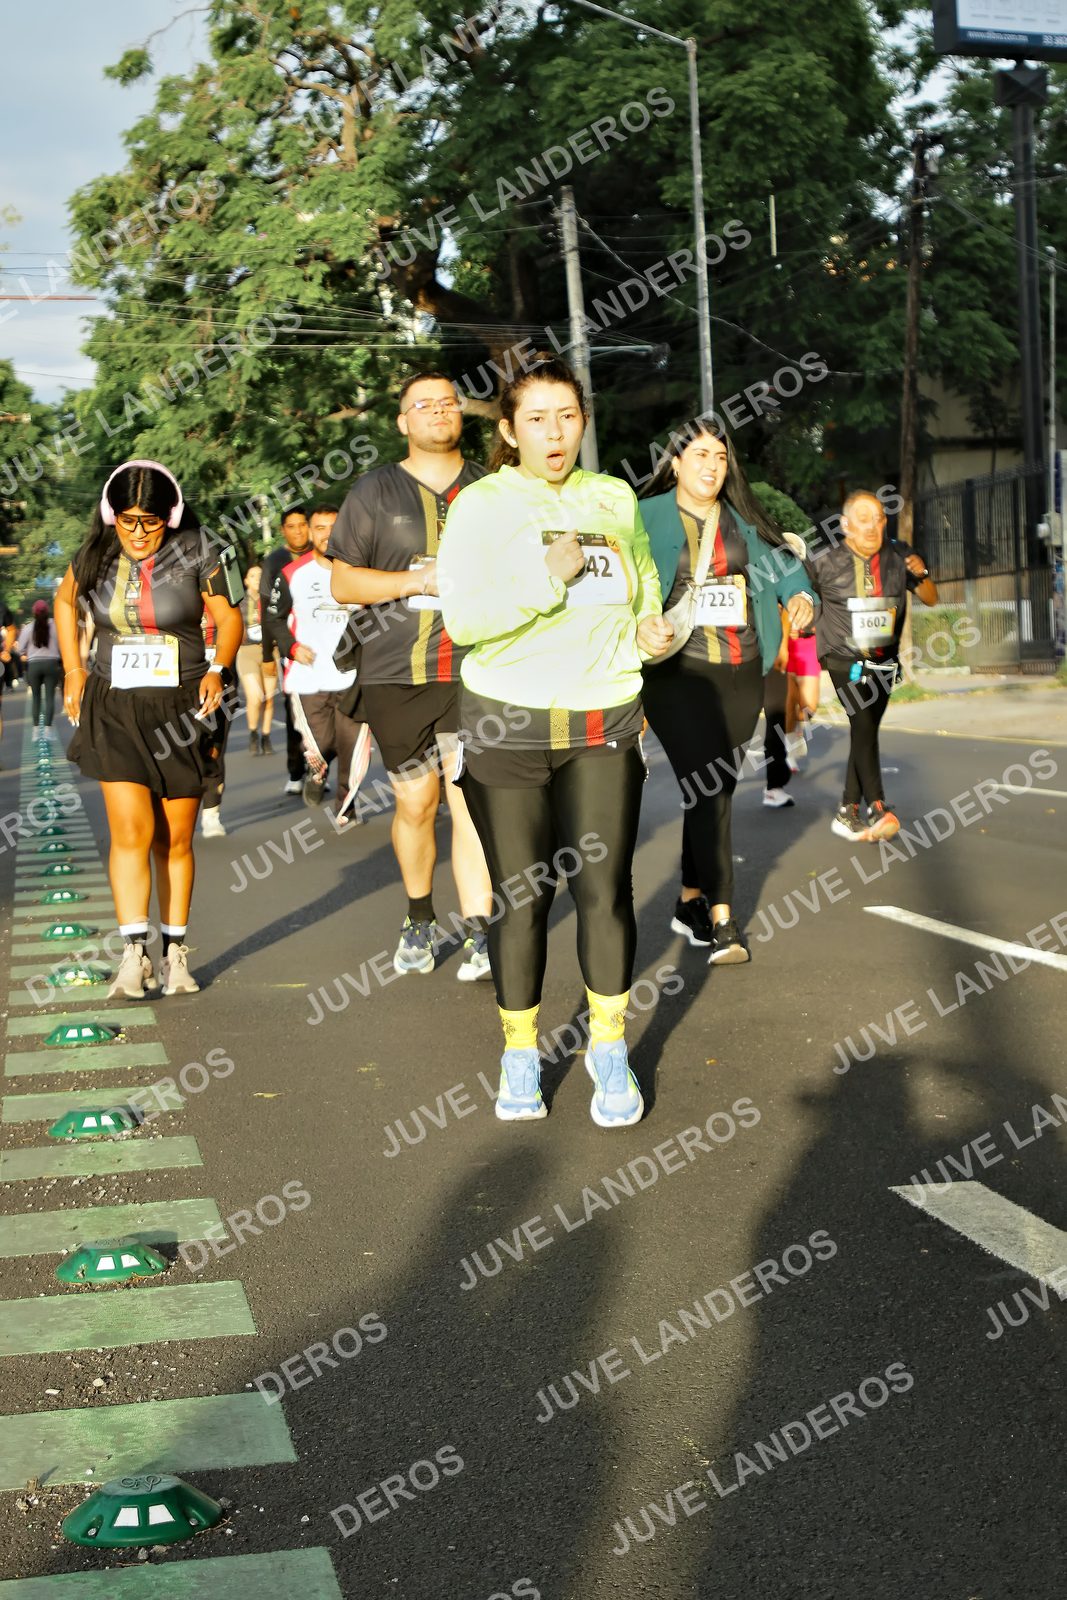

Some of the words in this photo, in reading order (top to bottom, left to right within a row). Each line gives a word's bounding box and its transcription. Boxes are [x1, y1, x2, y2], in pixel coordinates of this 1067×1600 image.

[699, 592, 735, 608] 7225
[859, 616, 887, 628] 3602
[121, 652, 163, 669] 7217
